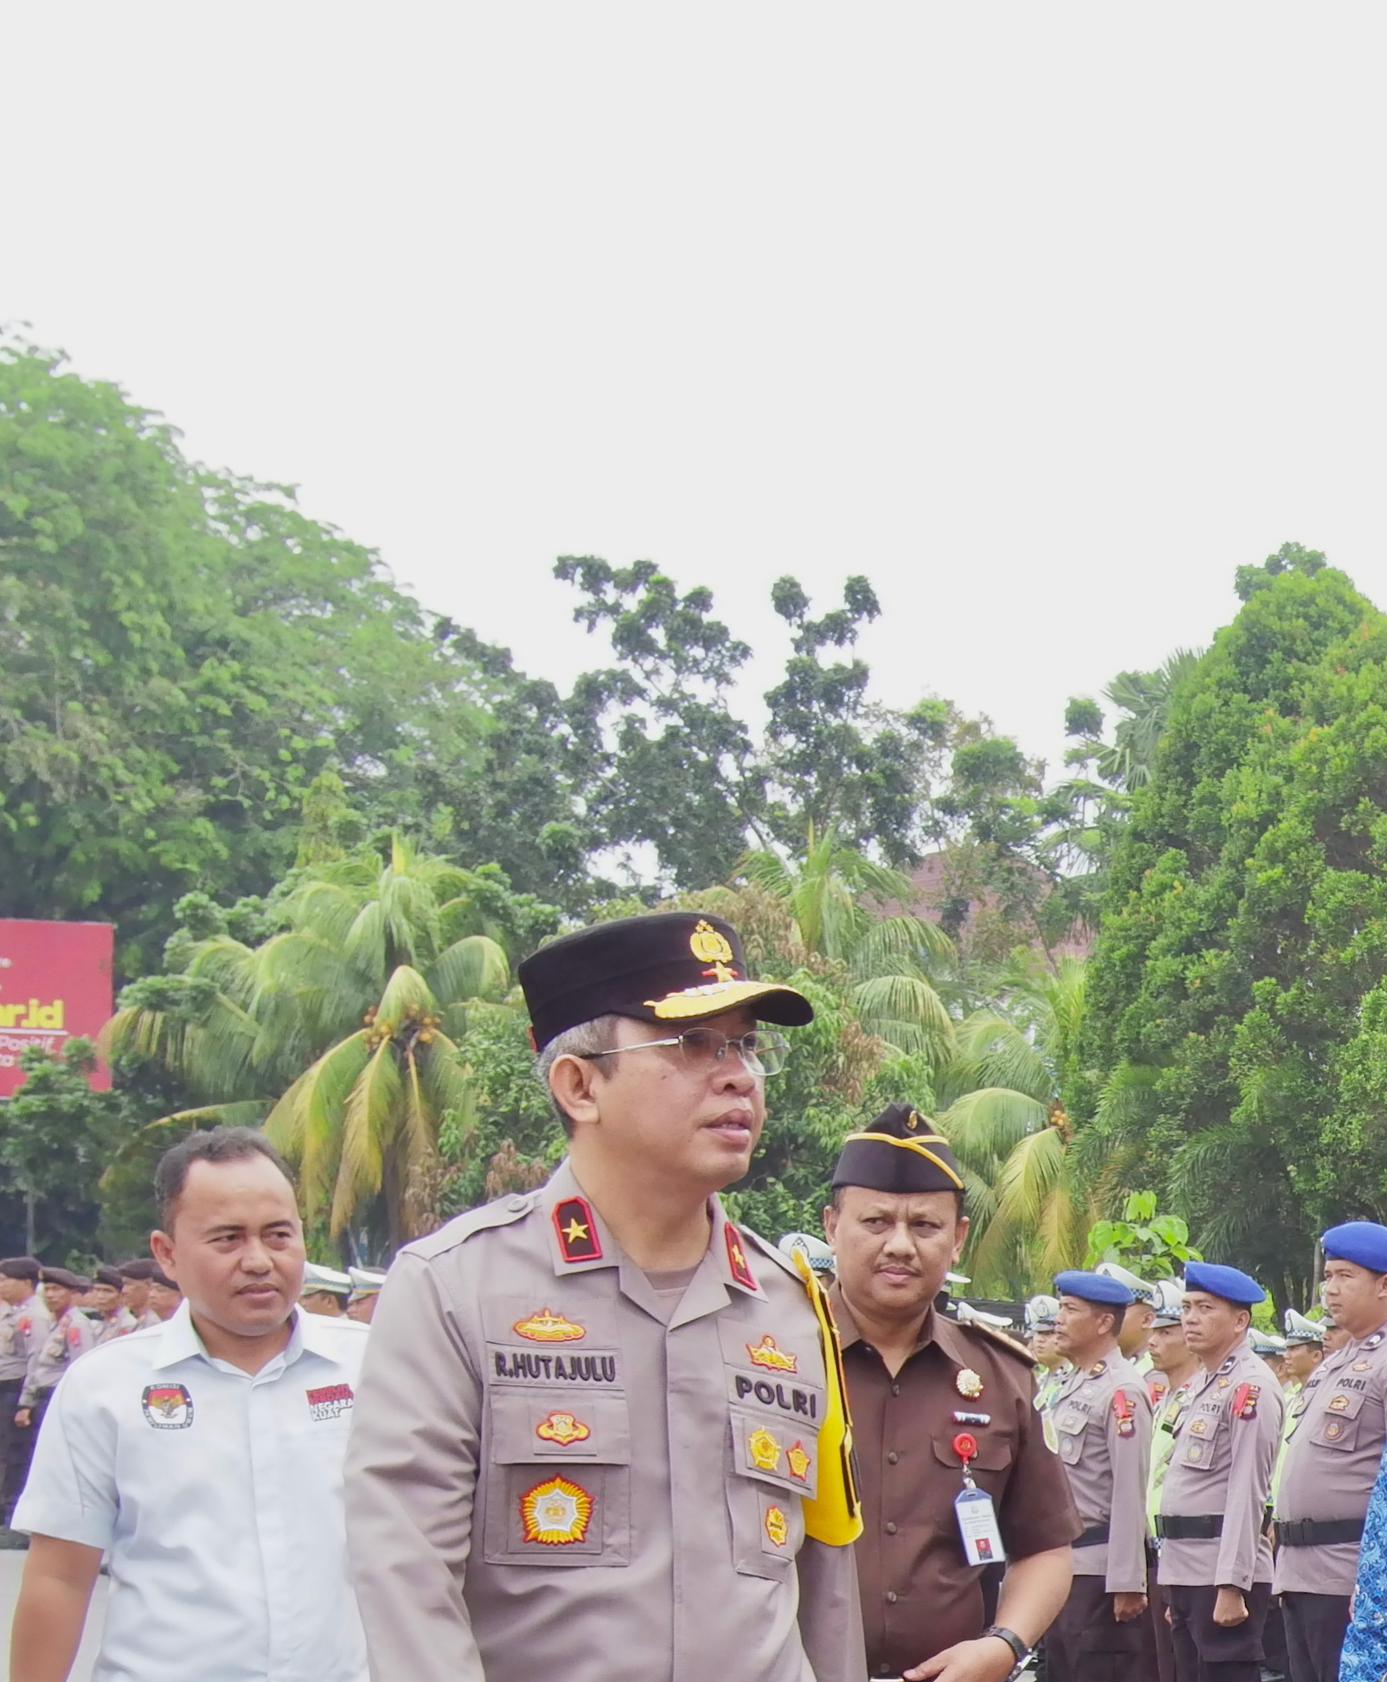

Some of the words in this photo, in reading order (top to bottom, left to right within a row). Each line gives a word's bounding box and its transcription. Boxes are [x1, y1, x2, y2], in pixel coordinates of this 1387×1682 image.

[494, 1351, 616, 1383] R.HUTAJULU
[734, 1374, 817, 1419] POLRI
[1336, 1377, 1368, 1391] POLRI
